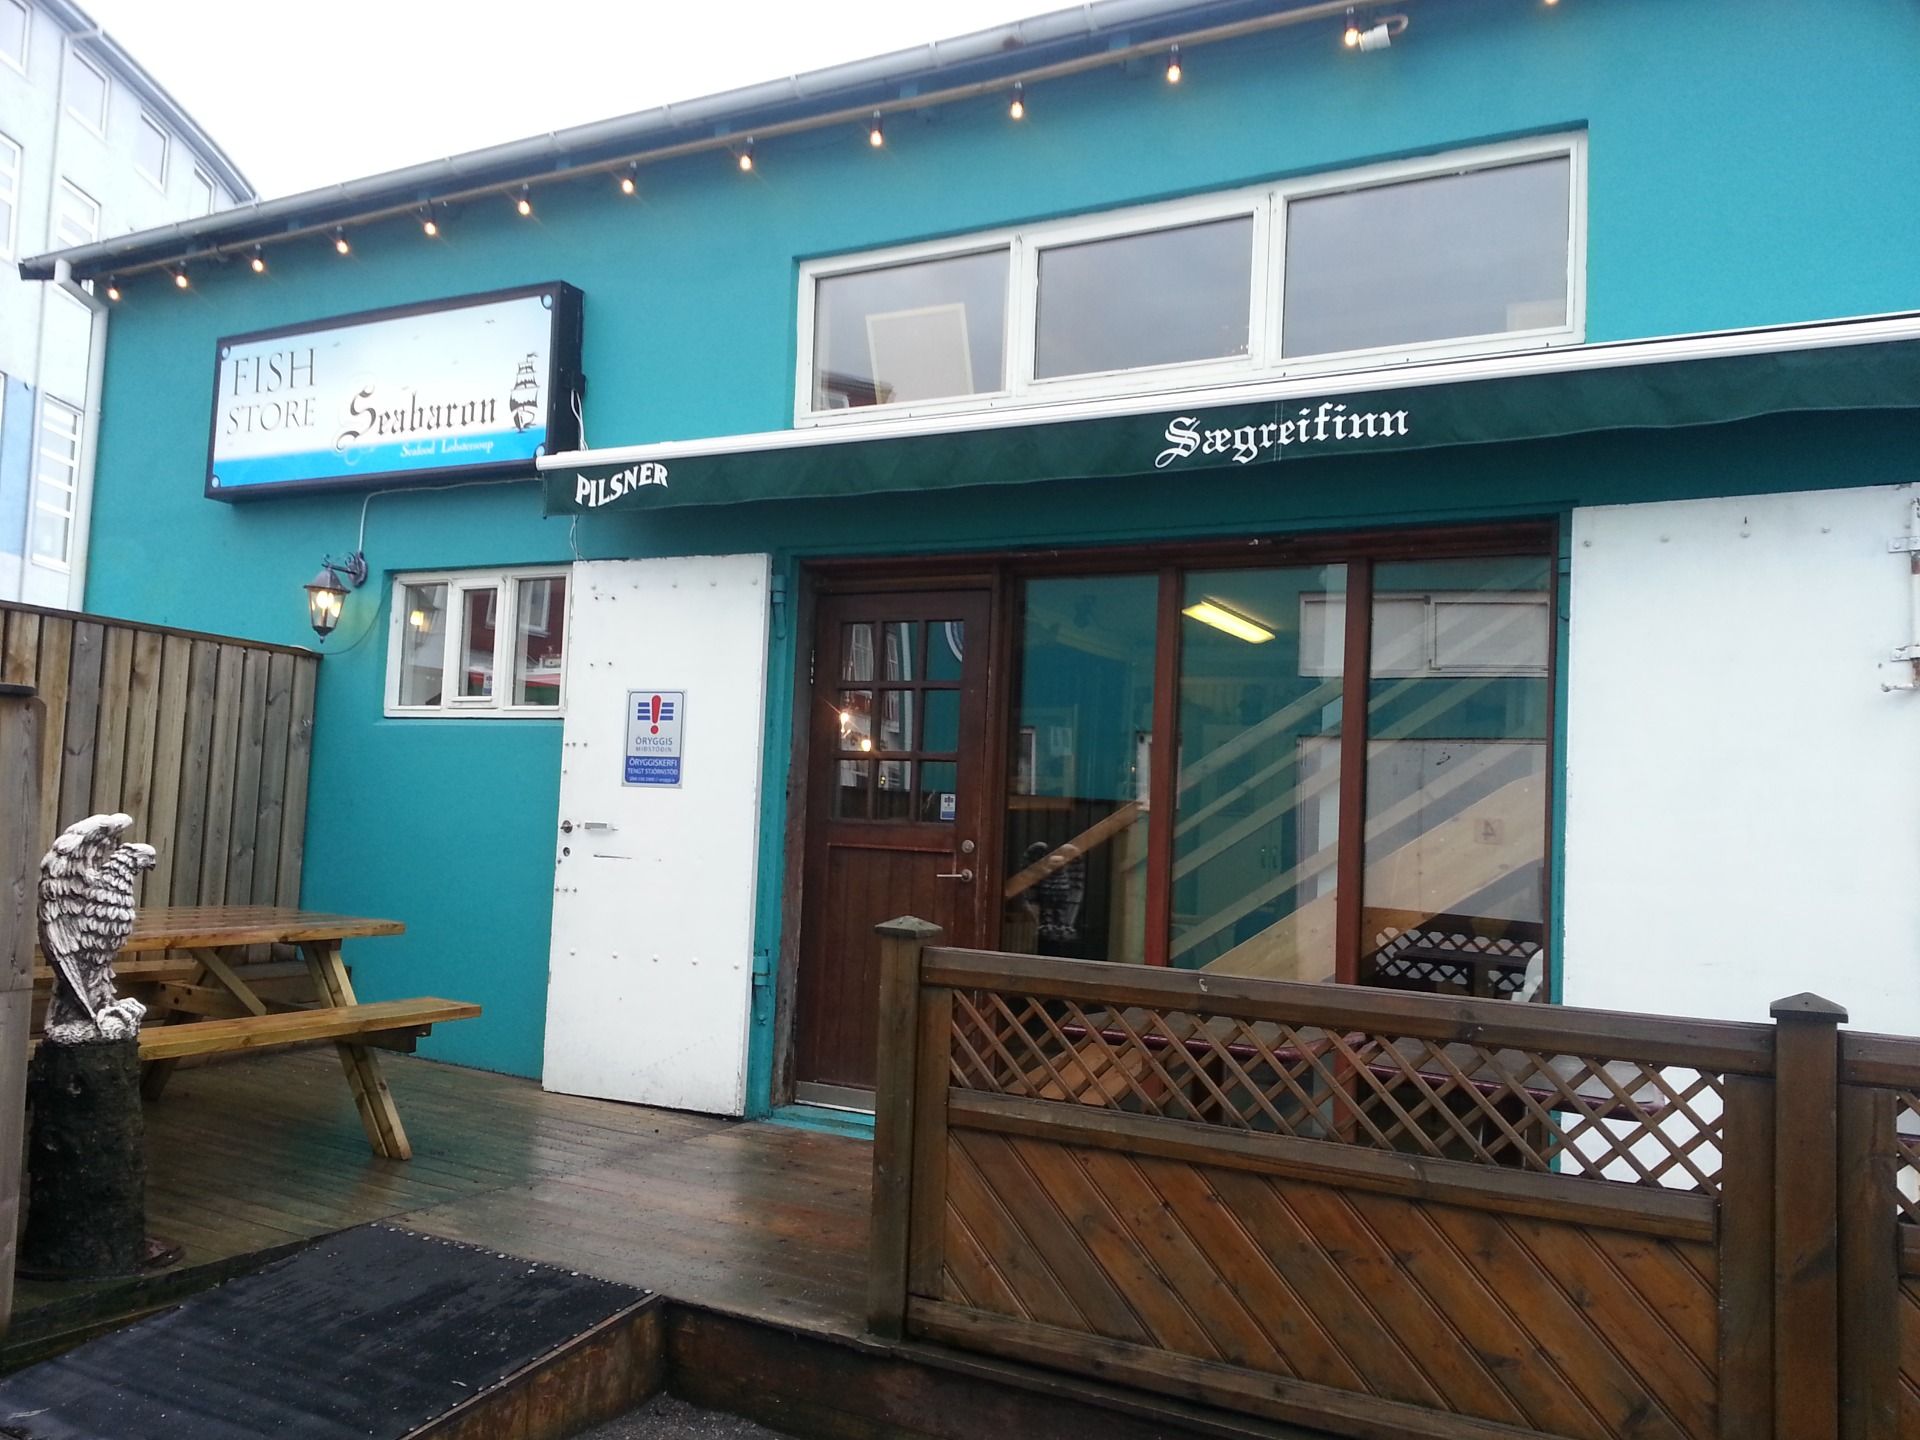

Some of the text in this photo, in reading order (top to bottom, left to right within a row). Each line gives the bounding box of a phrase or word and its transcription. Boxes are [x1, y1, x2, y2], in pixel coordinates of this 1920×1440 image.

[233, 348, 316, 396] FISH
[226, 397, 316, 435] STORE
[336, 384, 496, 452] Seabaron
[1154, 402, 1409, 468] Sægreifinn
[574, 462, 668, 507] PILSNER
